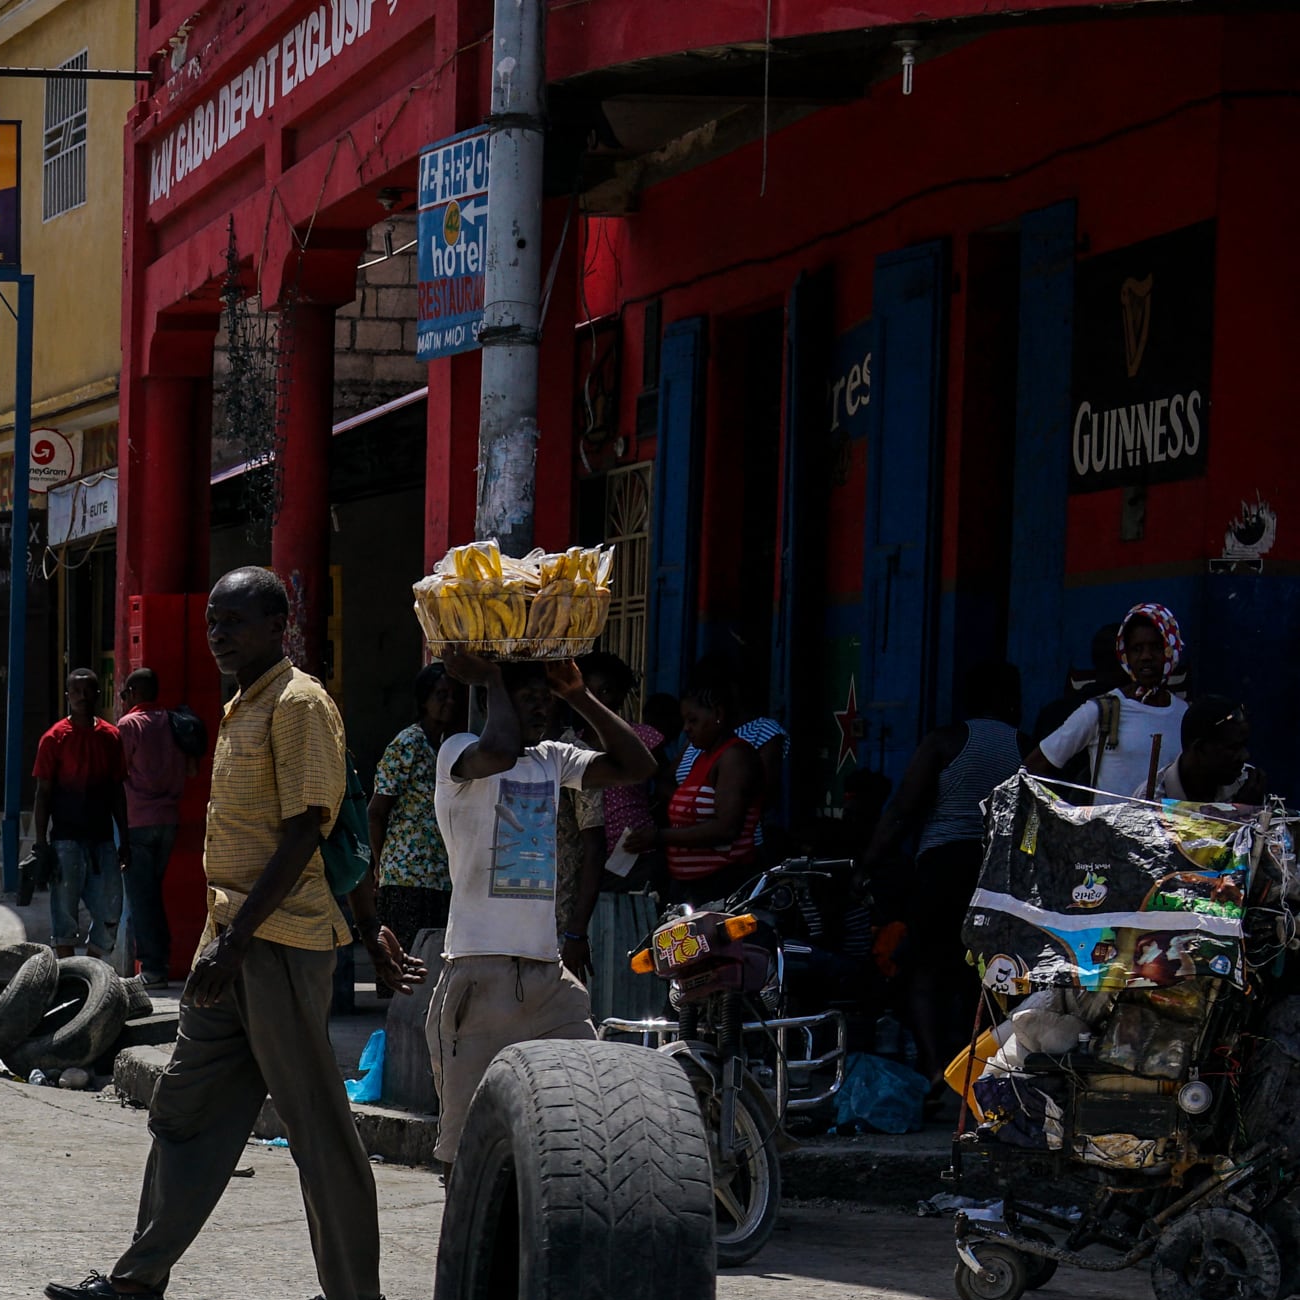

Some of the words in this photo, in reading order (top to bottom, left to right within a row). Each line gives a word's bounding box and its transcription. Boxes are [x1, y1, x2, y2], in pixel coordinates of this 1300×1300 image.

[419, 153, 439, 207] LE
[431, 225, 483, 278] hotel
[416, 332, 442, 354] MATIN
[443, 325, 466, 347] MIDI
[1072, 389, 1201, 476] GUINNESS
[29, 466, 67, 476] neyGram
